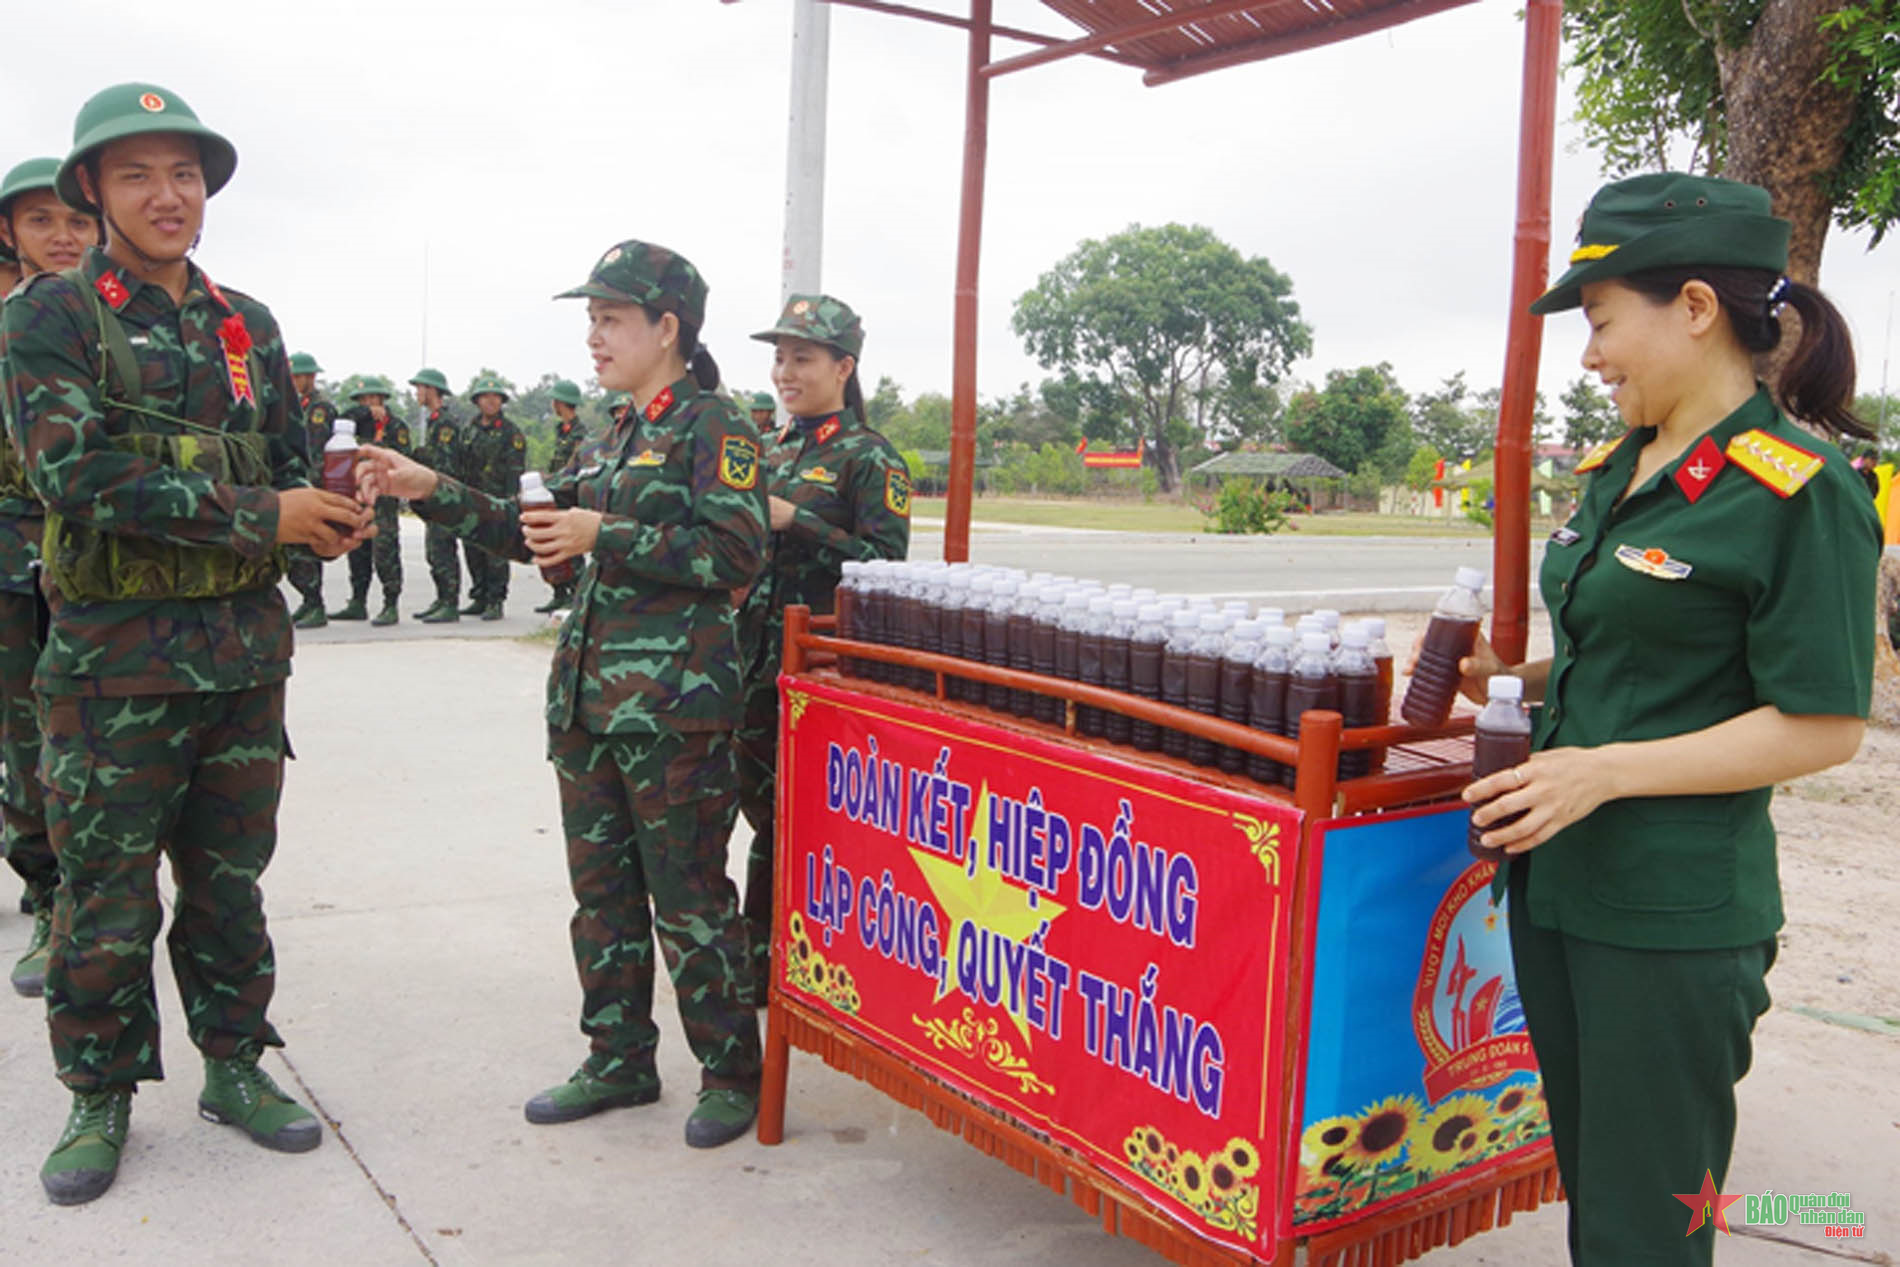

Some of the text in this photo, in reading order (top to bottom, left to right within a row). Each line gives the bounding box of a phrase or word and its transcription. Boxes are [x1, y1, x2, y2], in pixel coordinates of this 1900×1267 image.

[828, 735, 1198, 947] ĐOÀN KẾT, HIỆP ĐỒNG
[807, 845, 1224, 1119] LẬP CÔNG, QUYẾT THẮNG
